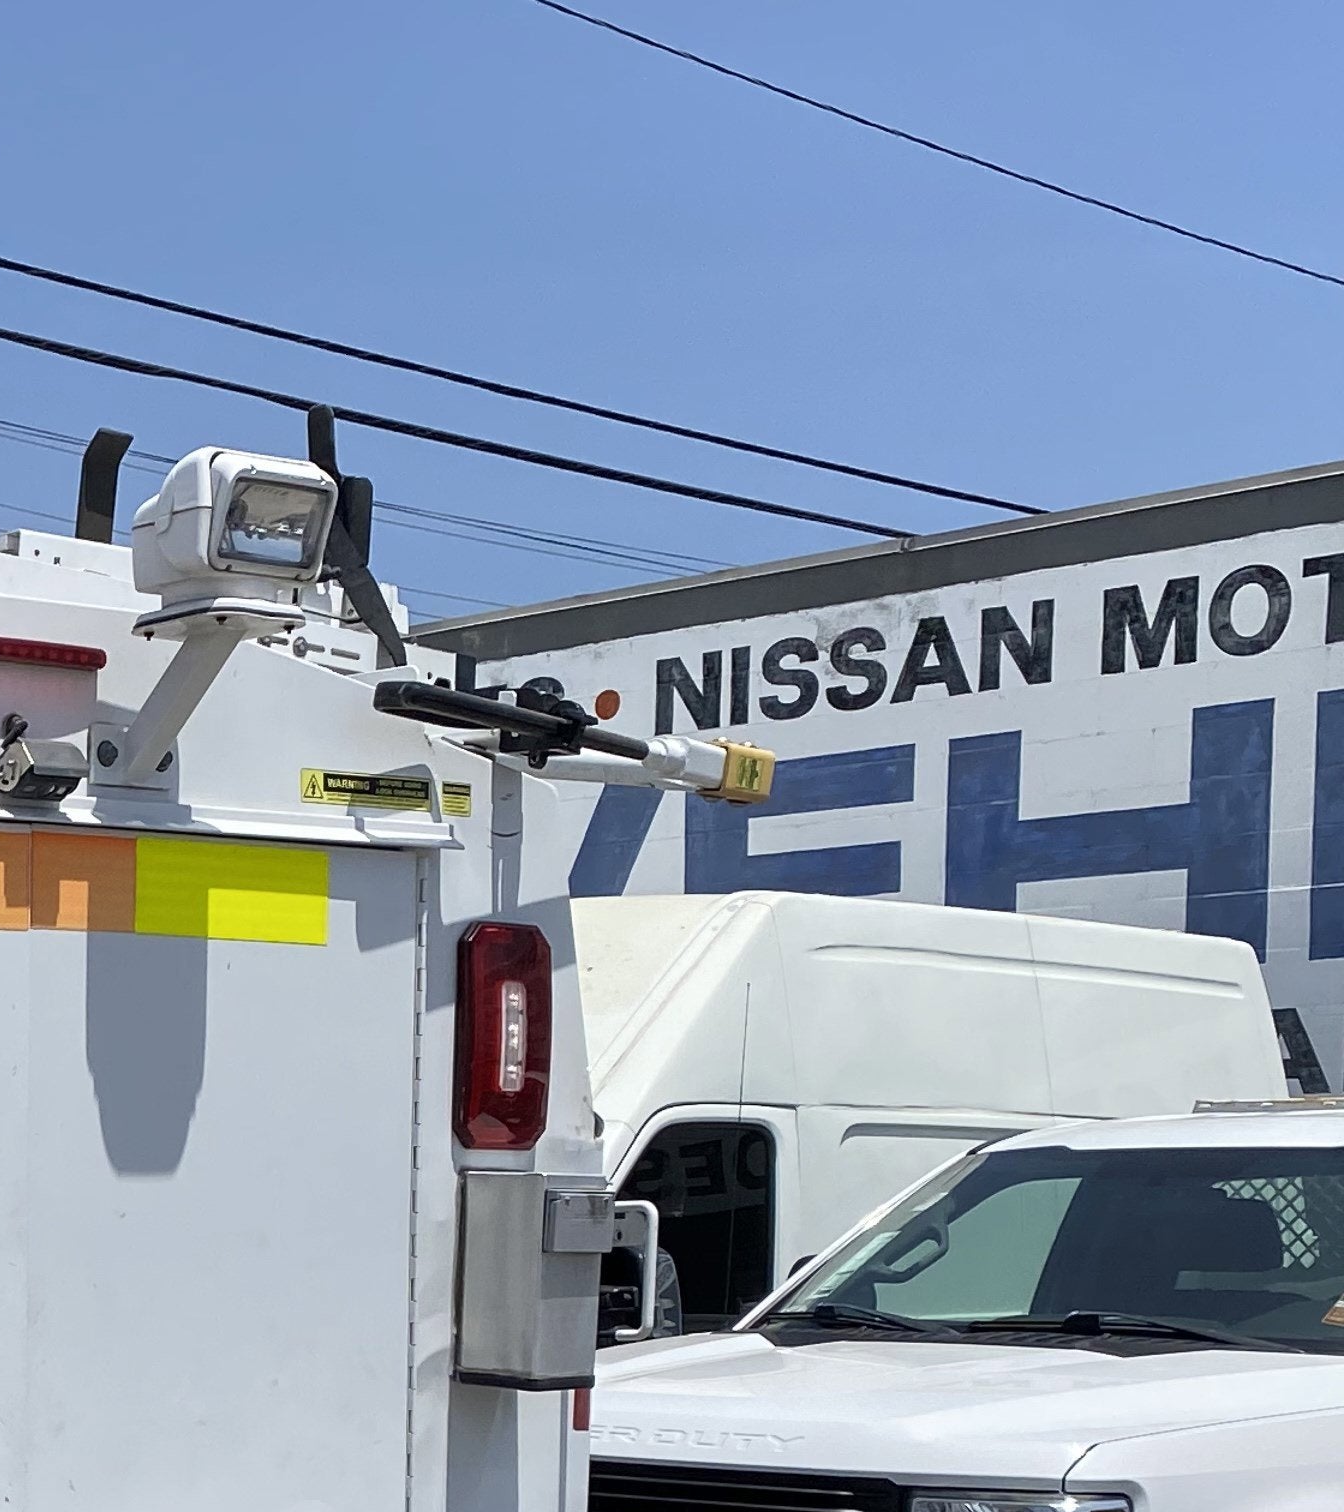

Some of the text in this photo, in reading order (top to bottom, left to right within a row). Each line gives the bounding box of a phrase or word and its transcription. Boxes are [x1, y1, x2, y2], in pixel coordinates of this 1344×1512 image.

[655, 553, 1344, 736] NISSAN MOT
[648, 1428, 805, 1452] DUTY
